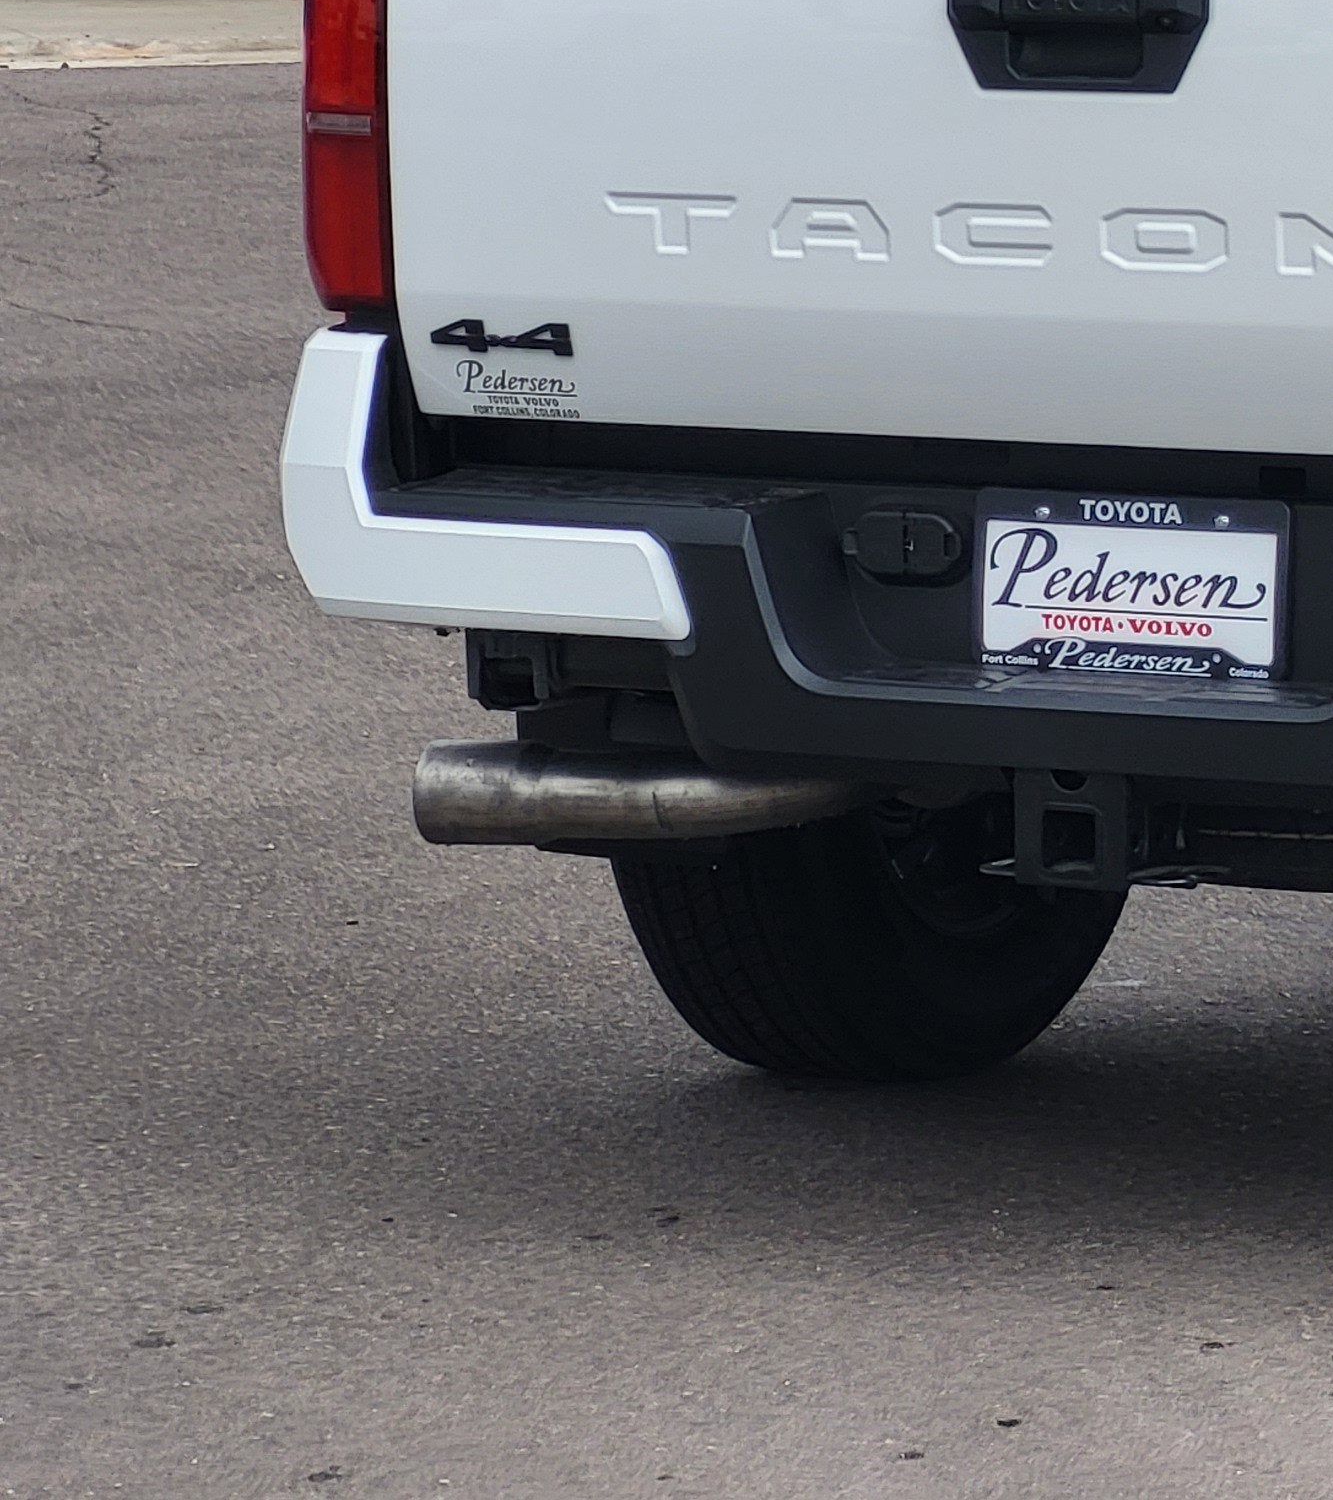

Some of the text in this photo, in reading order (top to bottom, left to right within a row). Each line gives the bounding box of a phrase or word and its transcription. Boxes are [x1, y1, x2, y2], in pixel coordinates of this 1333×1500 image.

[456, 359, 578, 393] Pedersen
[473, 404, 494, 415] FORT
[534, 407, 580, 419] COLORADO
[487, 395, 559, 407] TOYOTA VOLVO
[1079, 498, 1183, 525] TOYOTA
[989, 527, 1267, 610] Pedersen
[1041, 613, 1213, 638] TOYOTA VOLVO
[981, 653, 1039, 666] Fort Collins
[1045, 636, 1211, 675] Pedersen
[1228, 666, 1270, 680] Colorado
